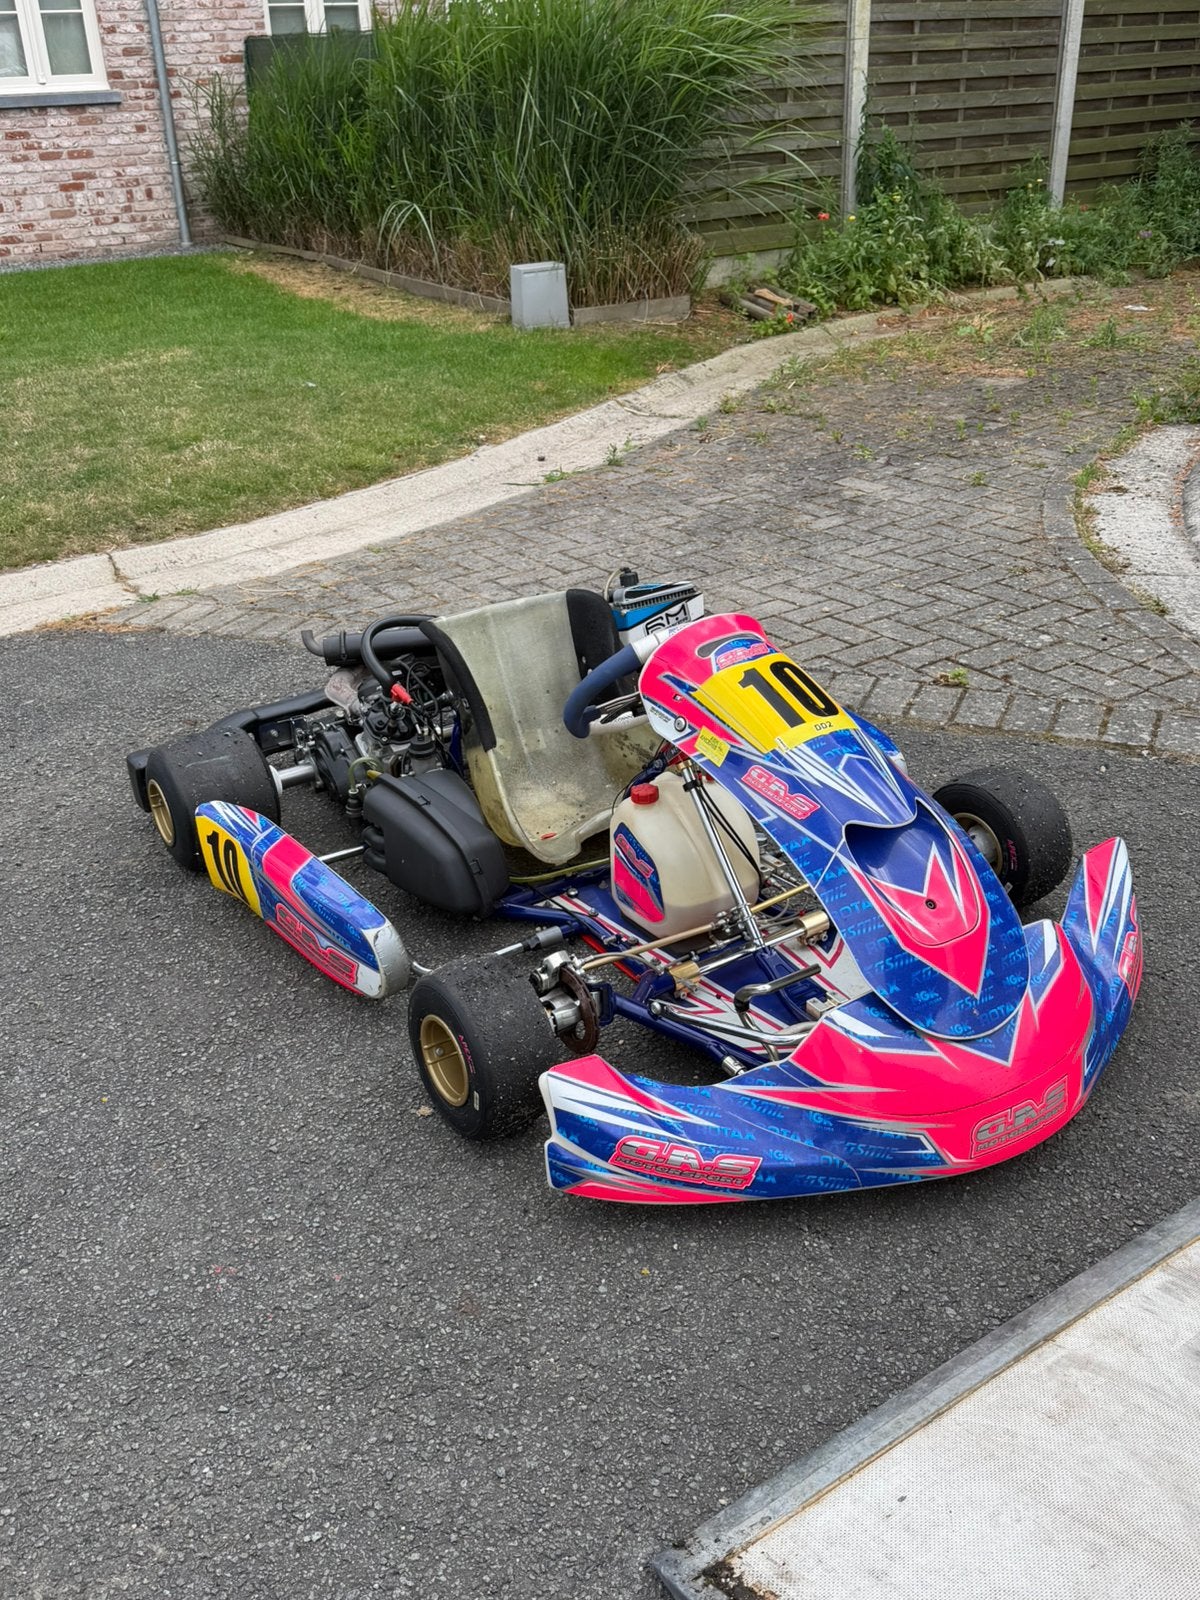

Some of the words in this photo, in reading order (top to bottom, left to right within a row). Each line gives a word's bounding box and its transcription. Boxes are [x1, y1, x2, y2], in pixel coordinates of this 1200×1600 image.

[738, 661, 839, 729] 10
[814, 721, 833, 731] DD2
[206, 830, 248, 903] 10
[976, 1082, 1065, 1141] G.A.S
[614, 1156, 746, 1187] MOTORSPORT
[621, 1139, 756, 1176] G.A.S
